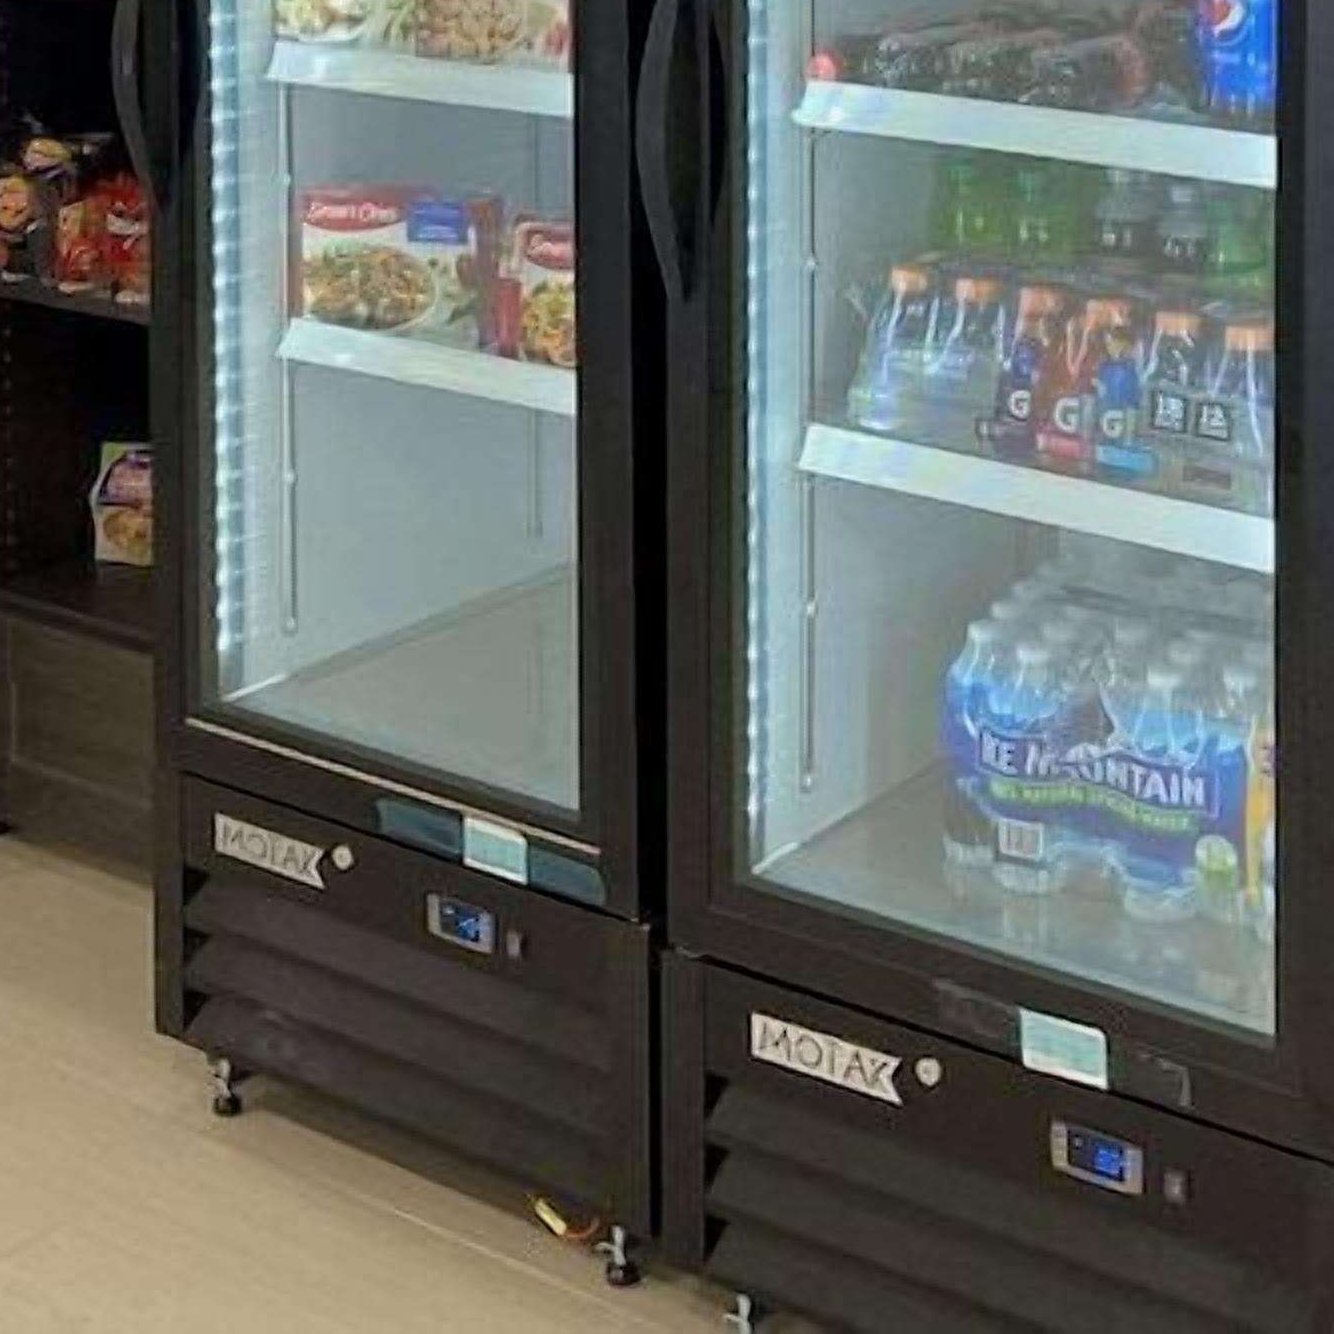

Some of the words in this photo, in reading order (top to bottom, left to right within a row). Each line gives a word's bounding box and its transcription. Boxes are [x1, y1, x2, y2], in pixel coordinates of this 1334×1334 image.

[1053, 396, 1080, 434] G
[1099, 409, 1124, 439] G
[758, 1021, 889, 1096] MOTAK
